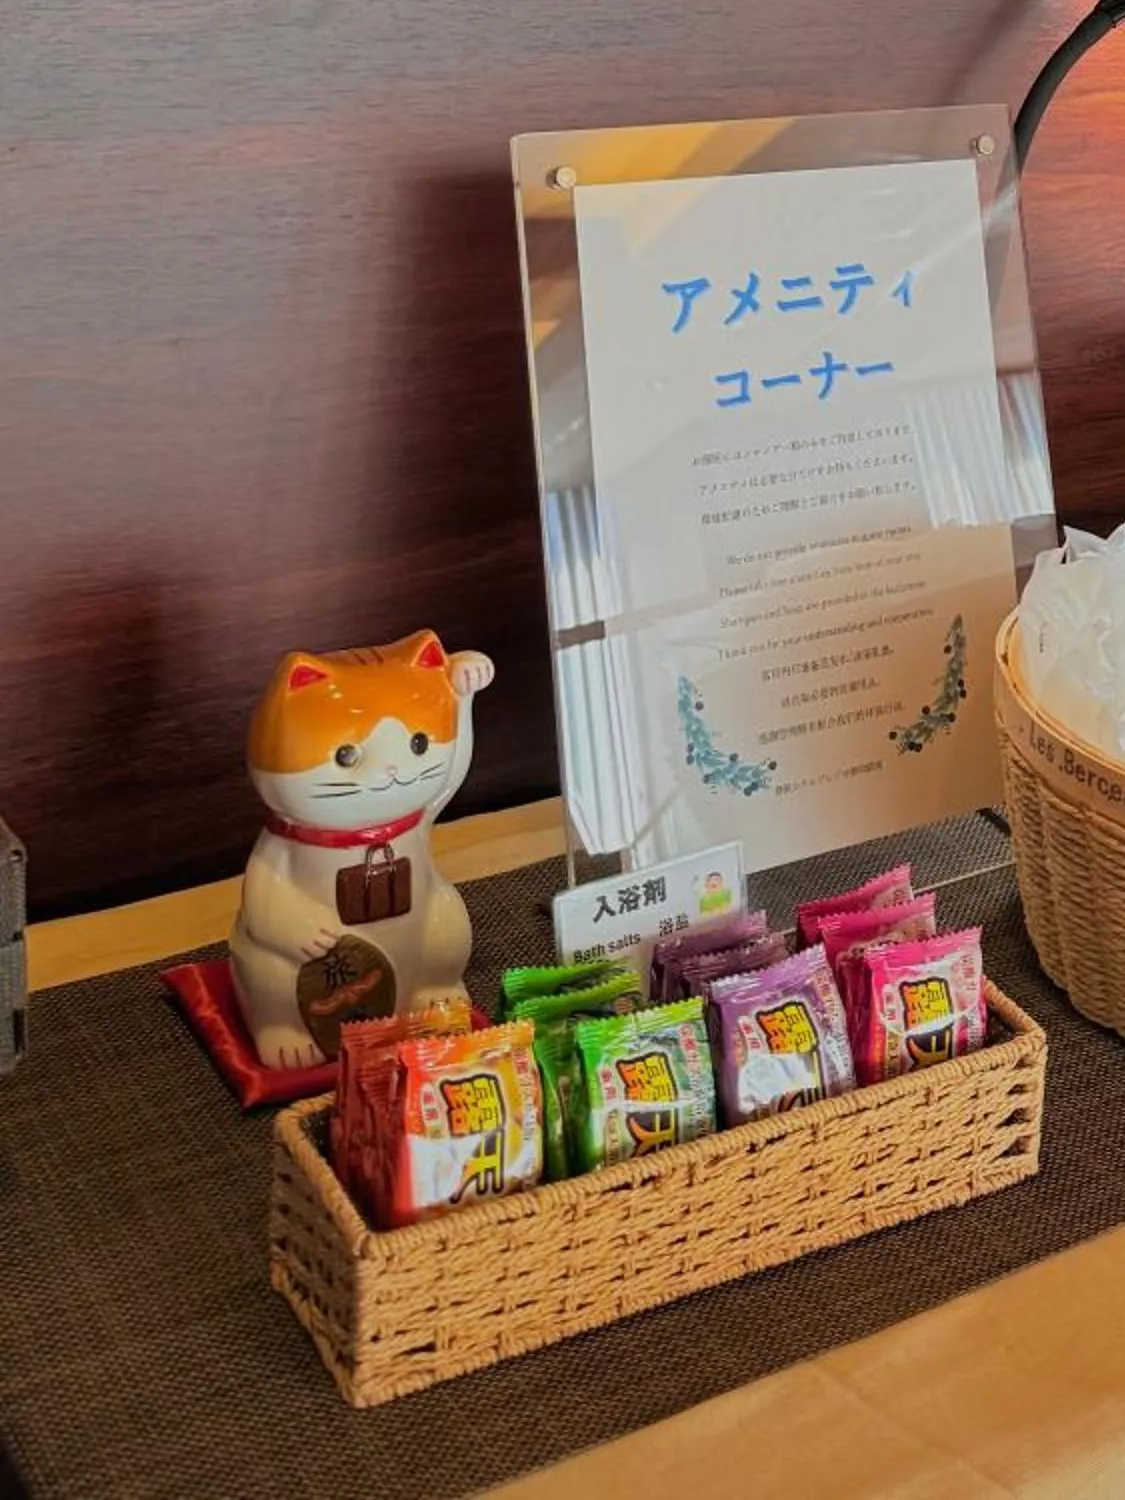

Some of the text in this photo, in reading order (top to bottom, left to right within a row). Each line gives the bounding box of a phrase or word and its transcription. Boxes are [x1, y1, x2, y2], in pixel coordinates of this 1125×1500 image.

[661, 263, 913, 334] アメニティ
[715, 351, 894, 407] コーナー
[1029, 719, 1055, 764] Les
[592, 875, 667, 924] 入浴剤
[573, 932, 641, 961] Bath salts
